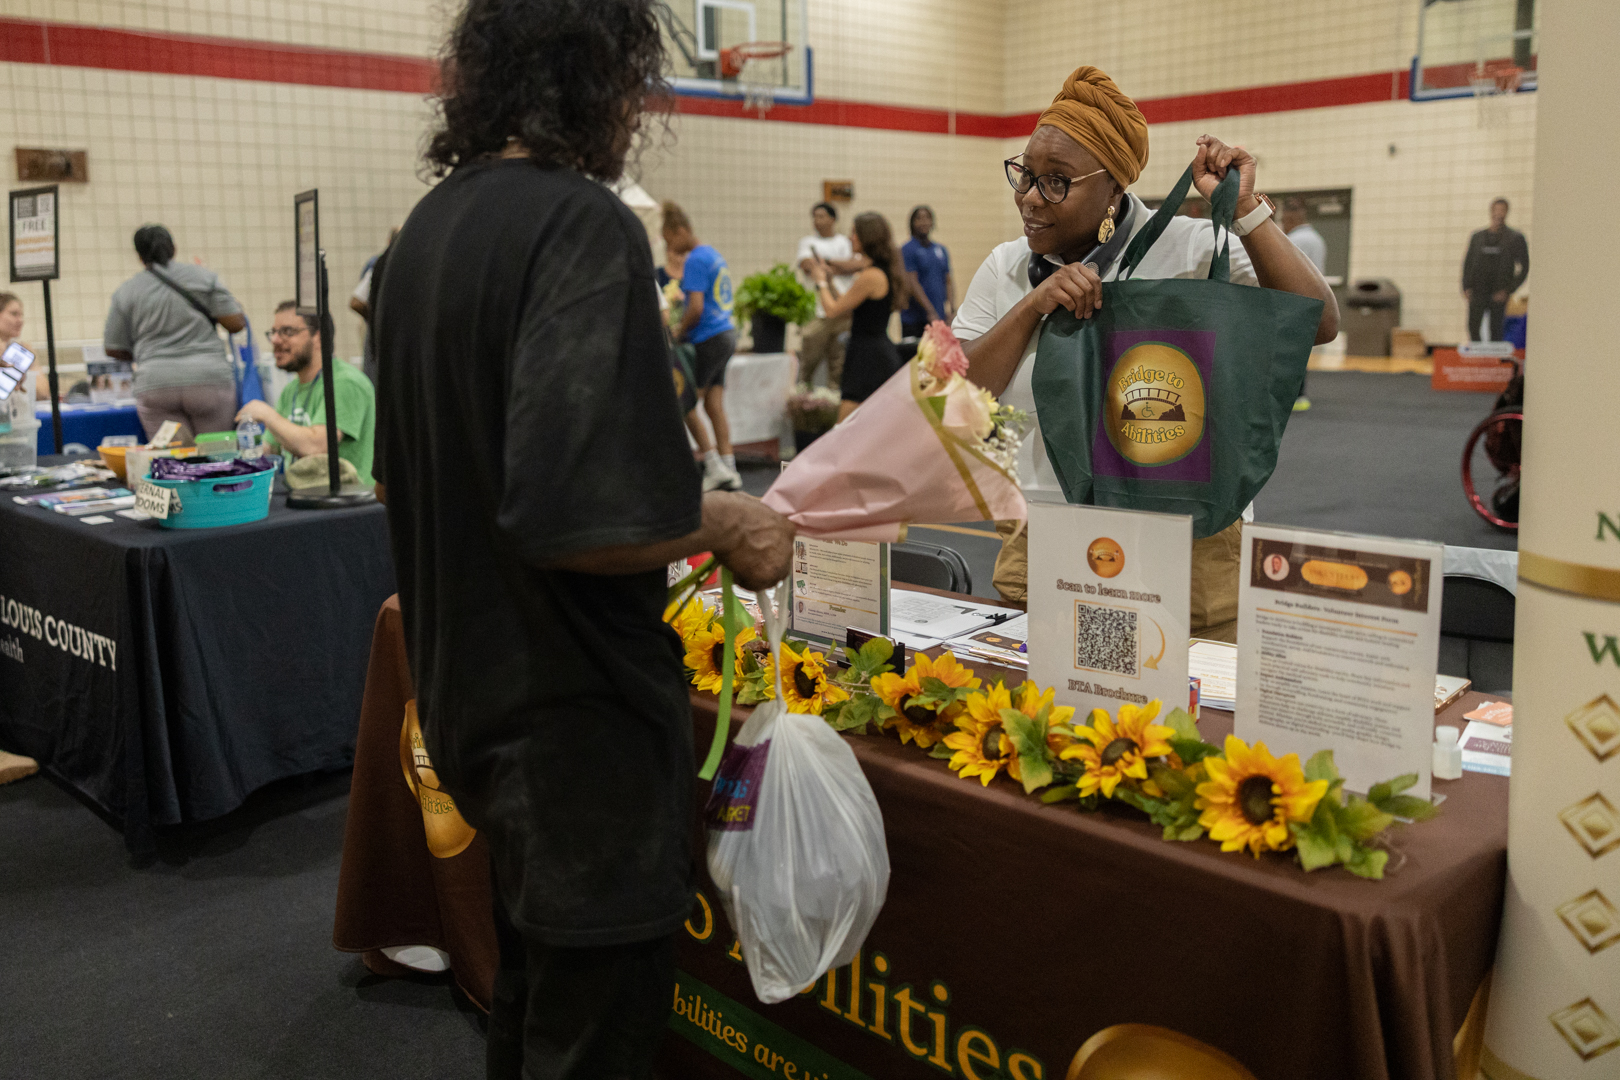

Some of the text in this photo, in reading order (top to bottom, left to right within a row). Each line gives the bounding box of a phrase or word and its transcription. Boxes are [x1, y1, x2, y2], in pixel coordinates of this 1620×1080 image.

[1118, 365, 1185, 393] Bridge to
[1121, 421, 1185, 444] Abilities
[1056, 578, 1161, 604] Scan to learn more
[0, 594, 117, 672] LOUIS COUNTY
[0, 634, 24, 664] ealth
[1067, 679, 1149, 705] BTA Brochure
[422, 794, 455, 815] ilities
[672, 983, 798, 1080] bilities are
